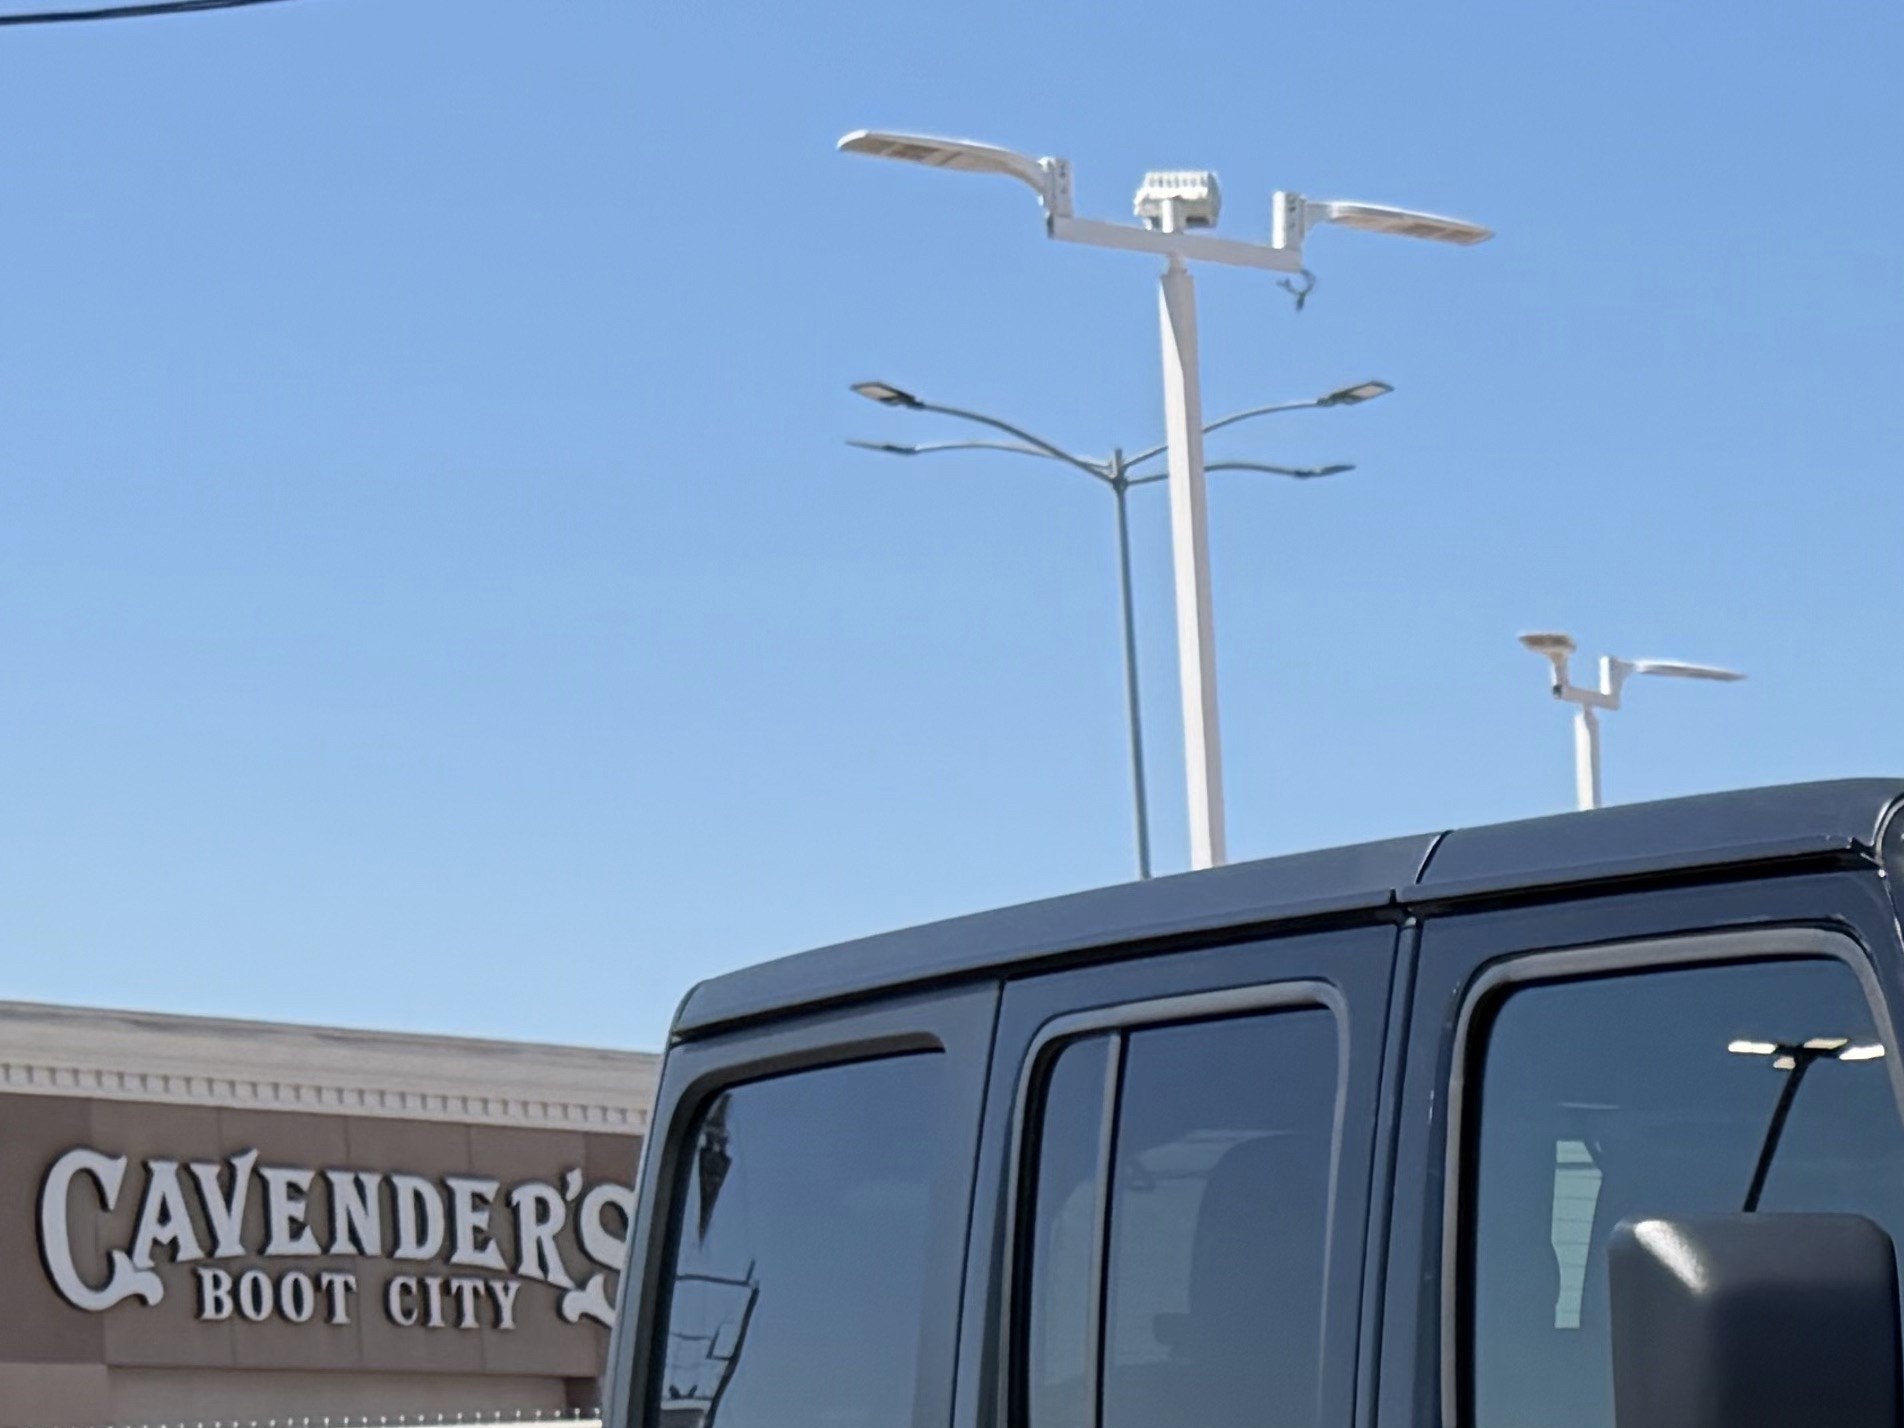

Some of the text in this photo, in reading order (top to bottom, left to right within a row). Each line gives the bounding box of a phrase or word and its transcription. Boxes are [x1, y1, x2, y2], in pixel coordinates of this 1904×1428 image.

[37, 1146, 638, 1330] CAVENDER'S
[197, 1266, 521, 1331] BOOT CITY
